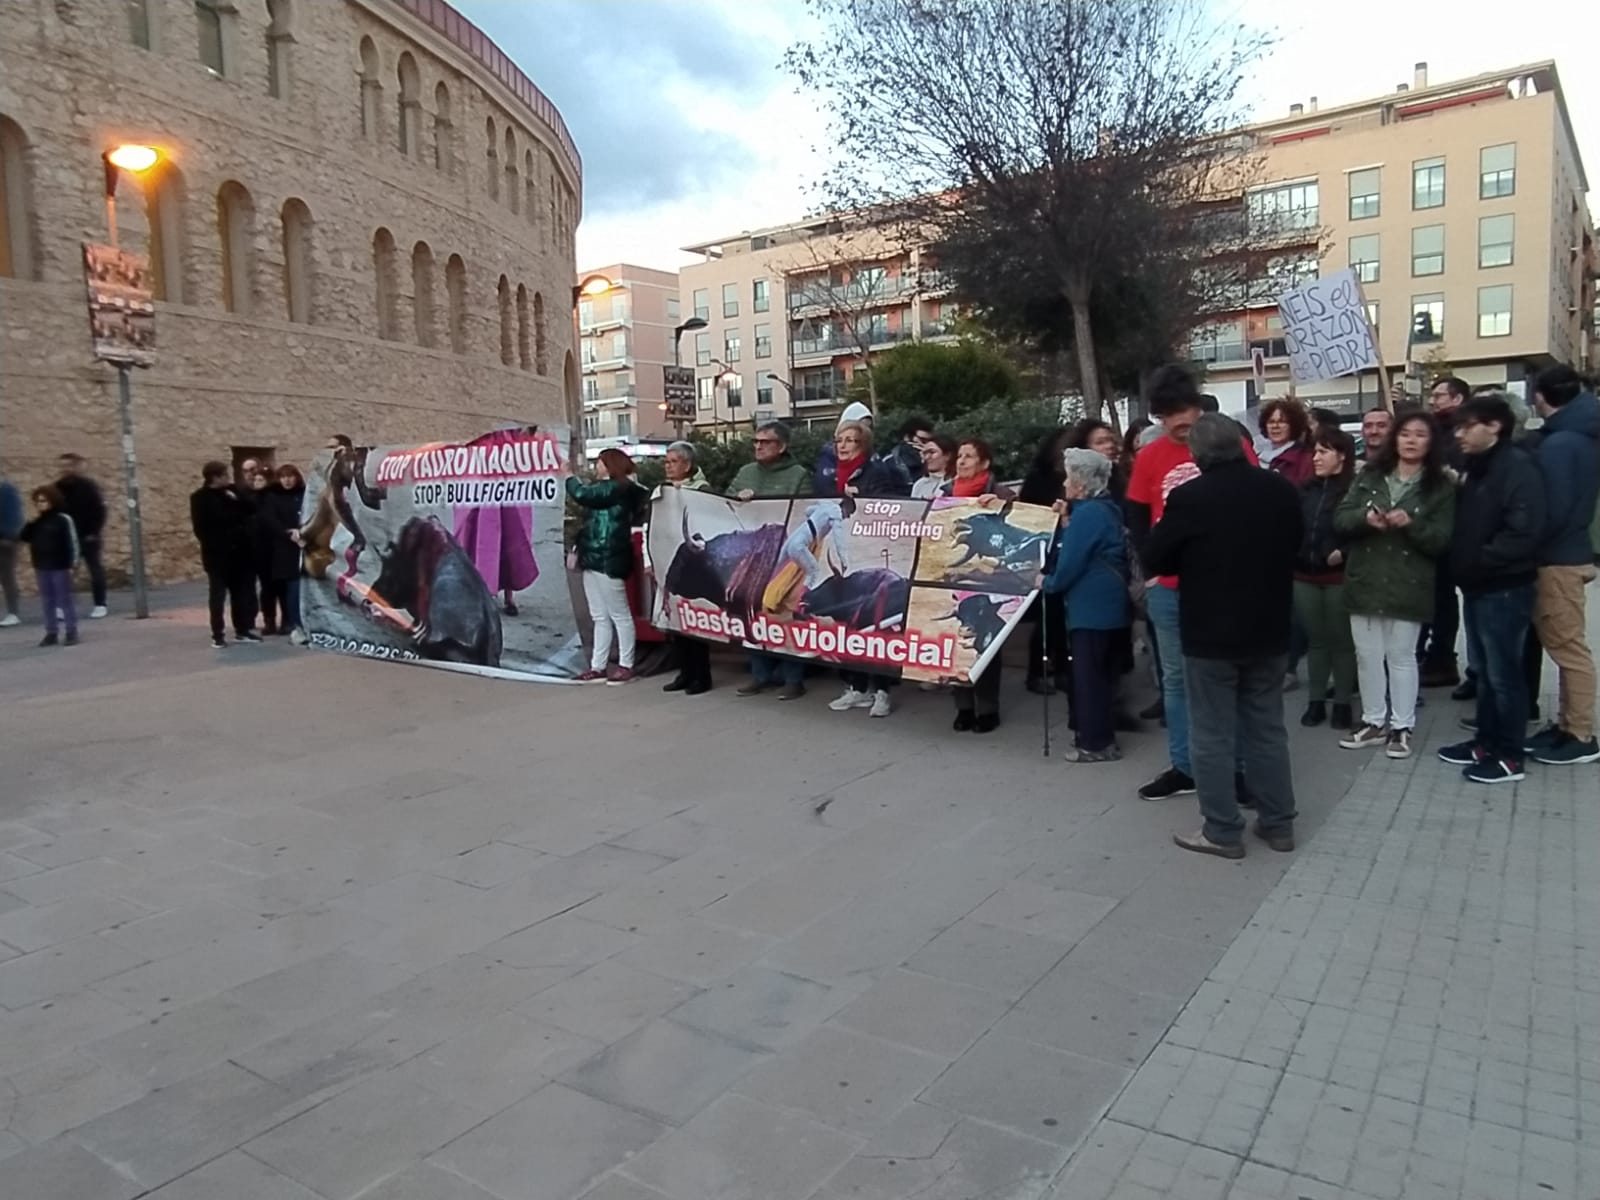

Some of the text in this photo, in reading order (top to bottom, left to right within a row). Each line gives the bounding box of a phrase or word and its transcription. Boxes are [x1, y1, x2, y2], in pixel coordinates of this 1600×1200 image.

[1331, 280, 1359, 309] el
[1309, 333, 1375, 379] PIEDRA
[377, 439, 560, 482] STOP TAUROMAQUIA
[414, 478, 556, 504] STOP BULLFIGHTING
[864, 501, 901, 517] stop
[852, 520, 944, 541] bullfighting
[679, 603, 954, 668] ¡basta de violencia!
